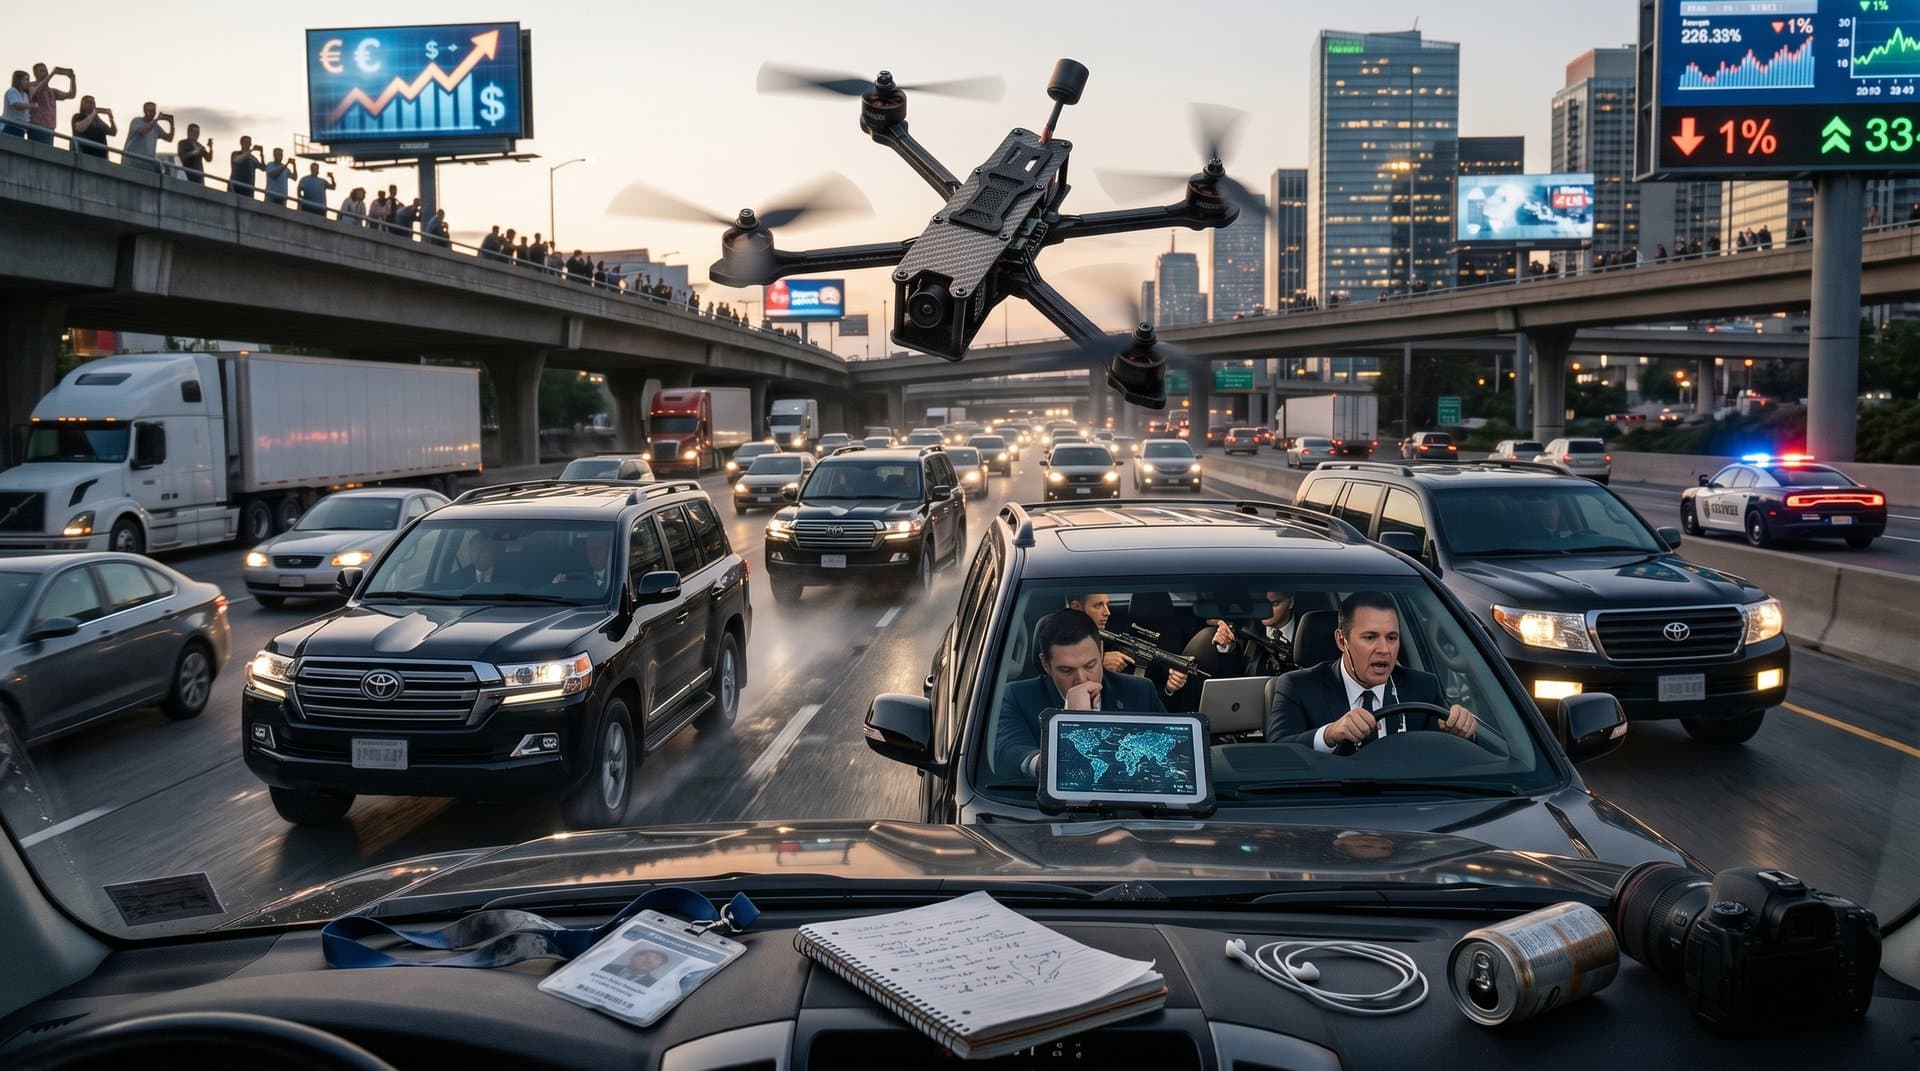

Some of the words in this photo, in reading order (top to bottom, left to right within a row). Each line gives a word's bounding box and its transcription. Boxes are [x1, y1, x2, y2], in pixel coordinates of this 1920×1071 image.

[1873, 0, 1889, 11] 1%
[1787, 18, 1814, 34] 1%
[480, 81, 505, 127] $
[1719, 118, 1777, 155] 1%
[1865, 117, 1920, 152] 33
